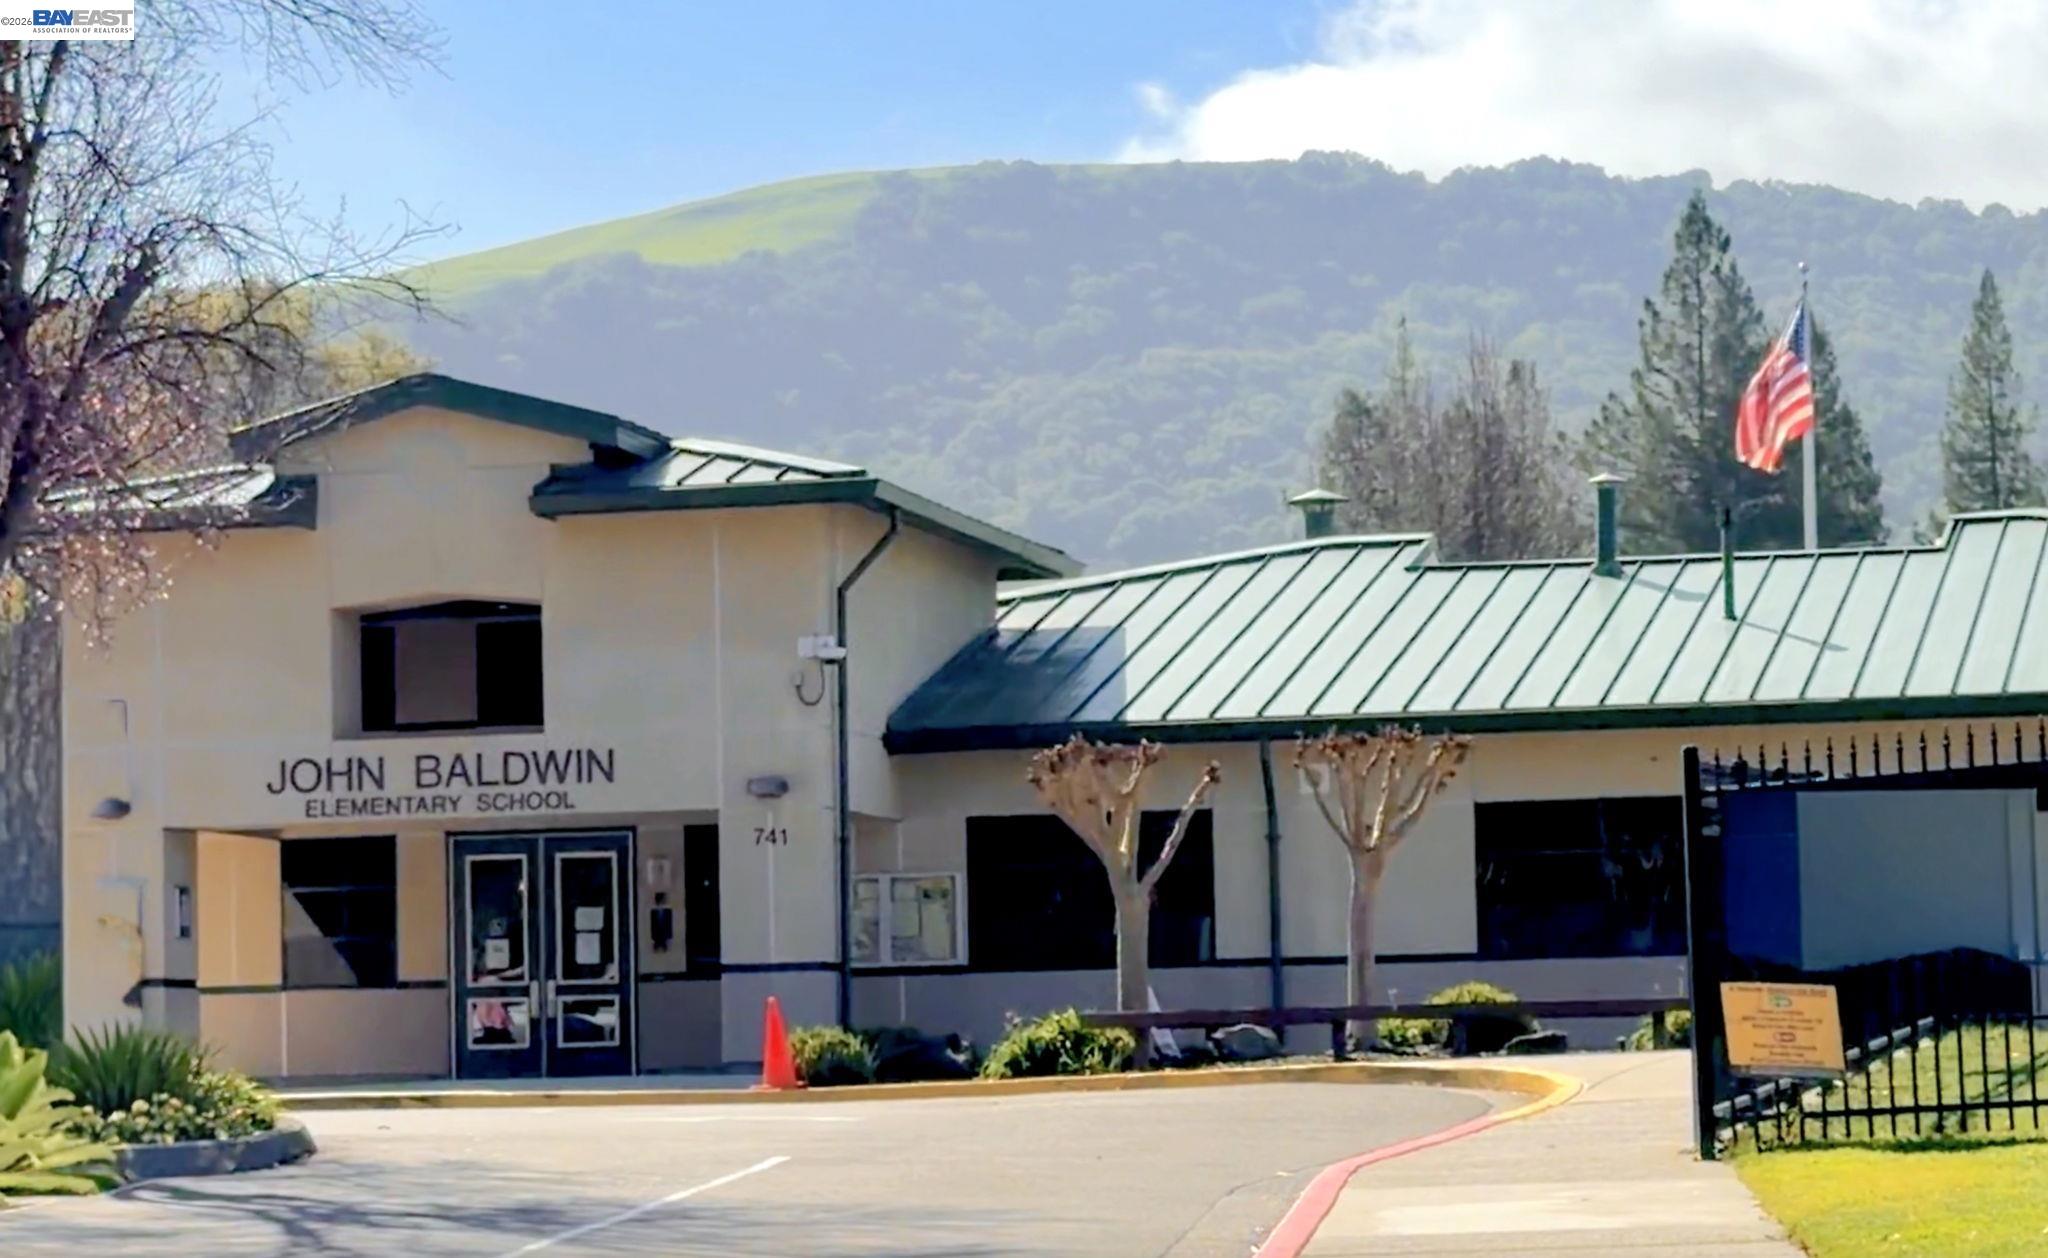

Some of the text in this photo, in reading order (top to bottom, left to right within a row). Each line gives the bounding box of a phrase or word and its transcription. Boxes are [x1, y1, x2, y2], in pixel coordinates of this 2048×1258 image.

[267, 749, 614, 794] JOHN BALDWIN
[306, 791, 576, 818] ELEMENTARY SCHOOL
[753, 828, 788, 845] 741
